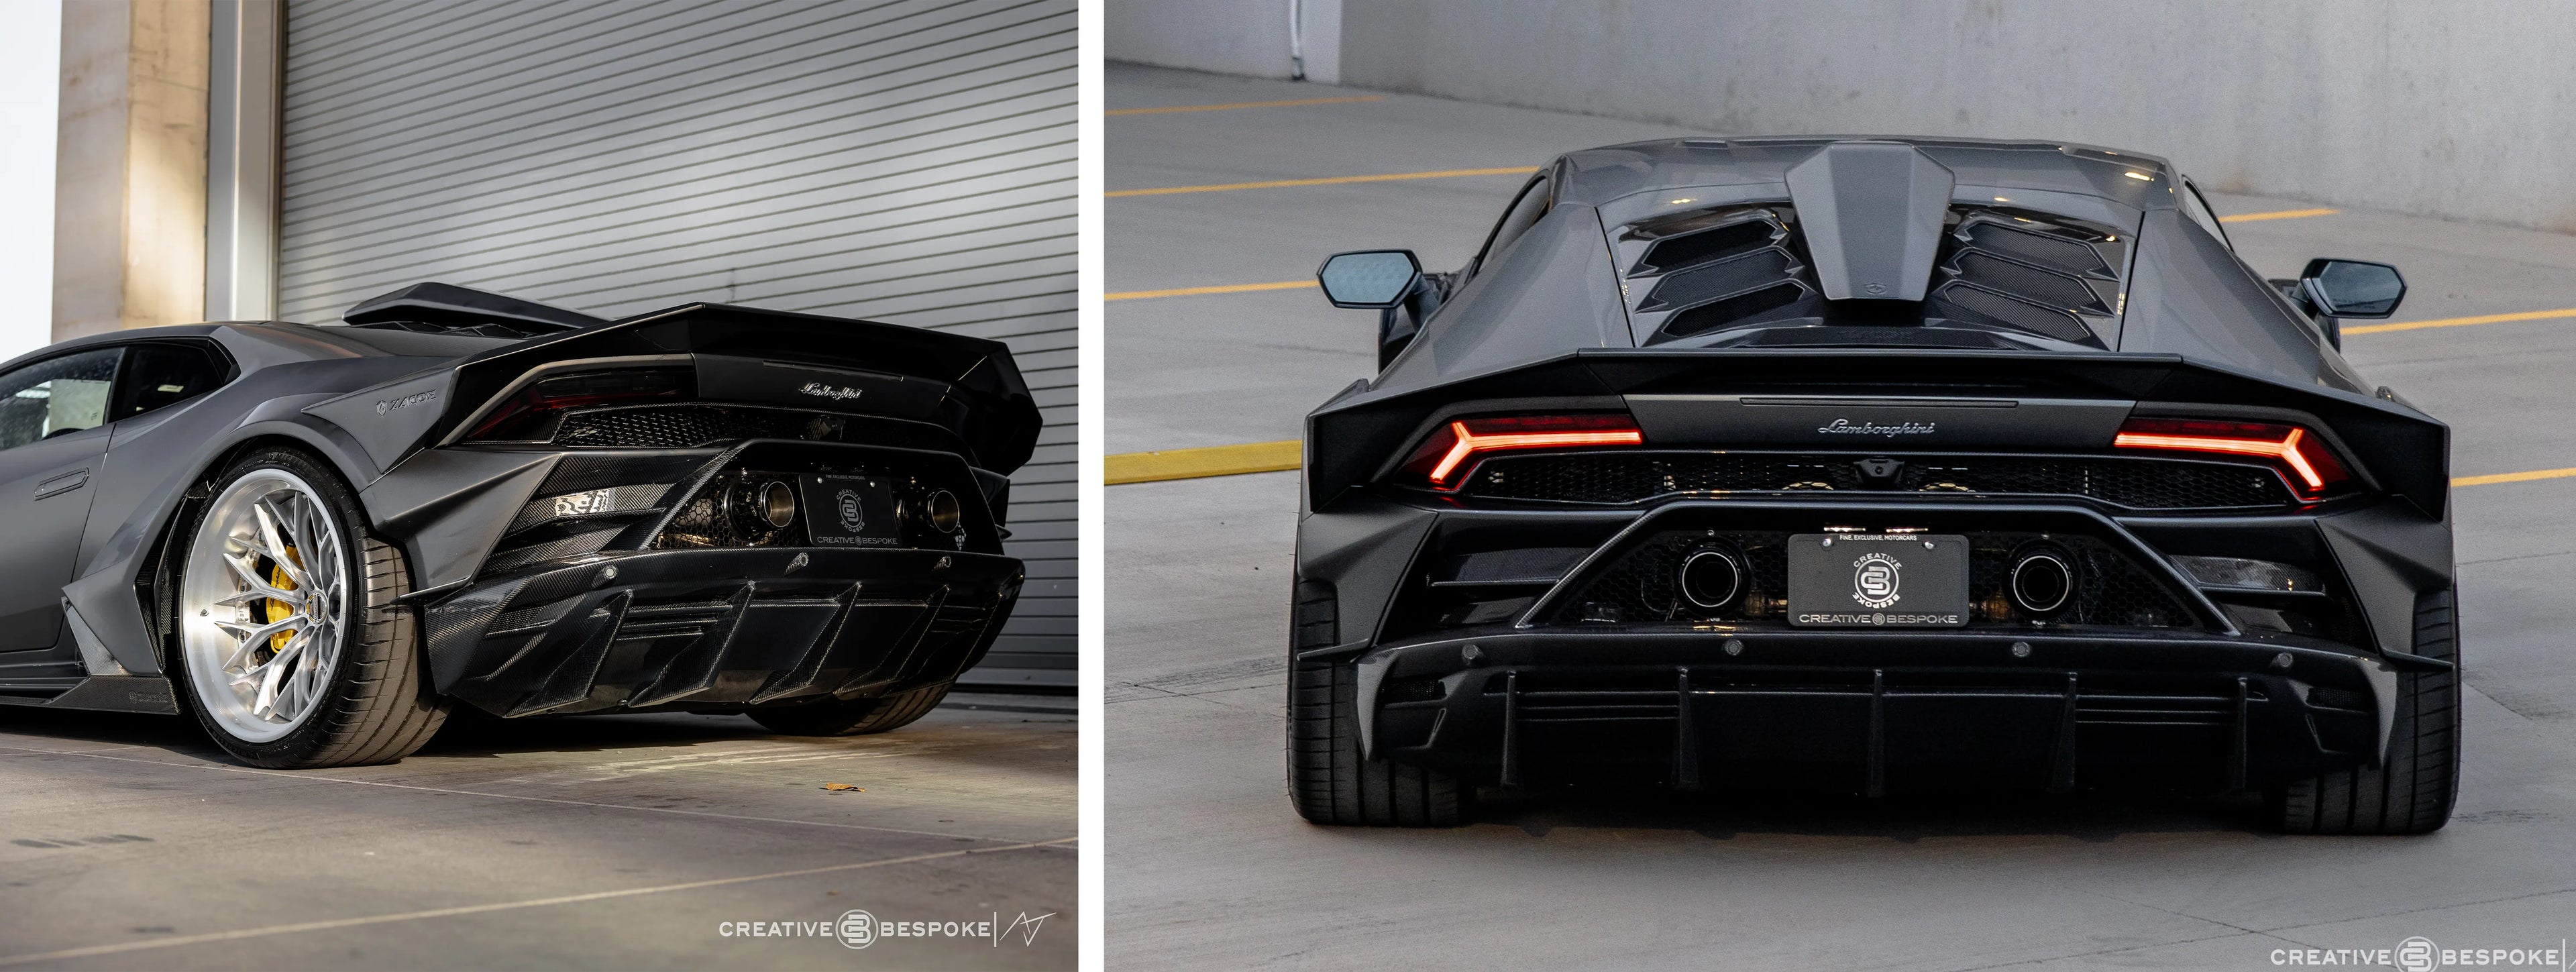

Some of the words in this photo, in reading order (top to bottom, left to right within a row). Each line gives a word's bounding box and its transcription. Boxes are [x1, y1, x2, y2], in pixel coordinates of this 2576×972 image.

[798, 382, 863, 400] Lamborghini
[1817, 419, 1935, 438] Lamborghini
[836, 489, 861, 502] CREATIVE
[840, 519, 865, 533] BESPOKE
[1854, 553, 1902, 570] CREATIVE
[1852, 592, 1900, 609] BESPOKE
[1799, 614, 1871, 623] CREATIVE
[1886, 615, 1958, 623] BESPOKE
